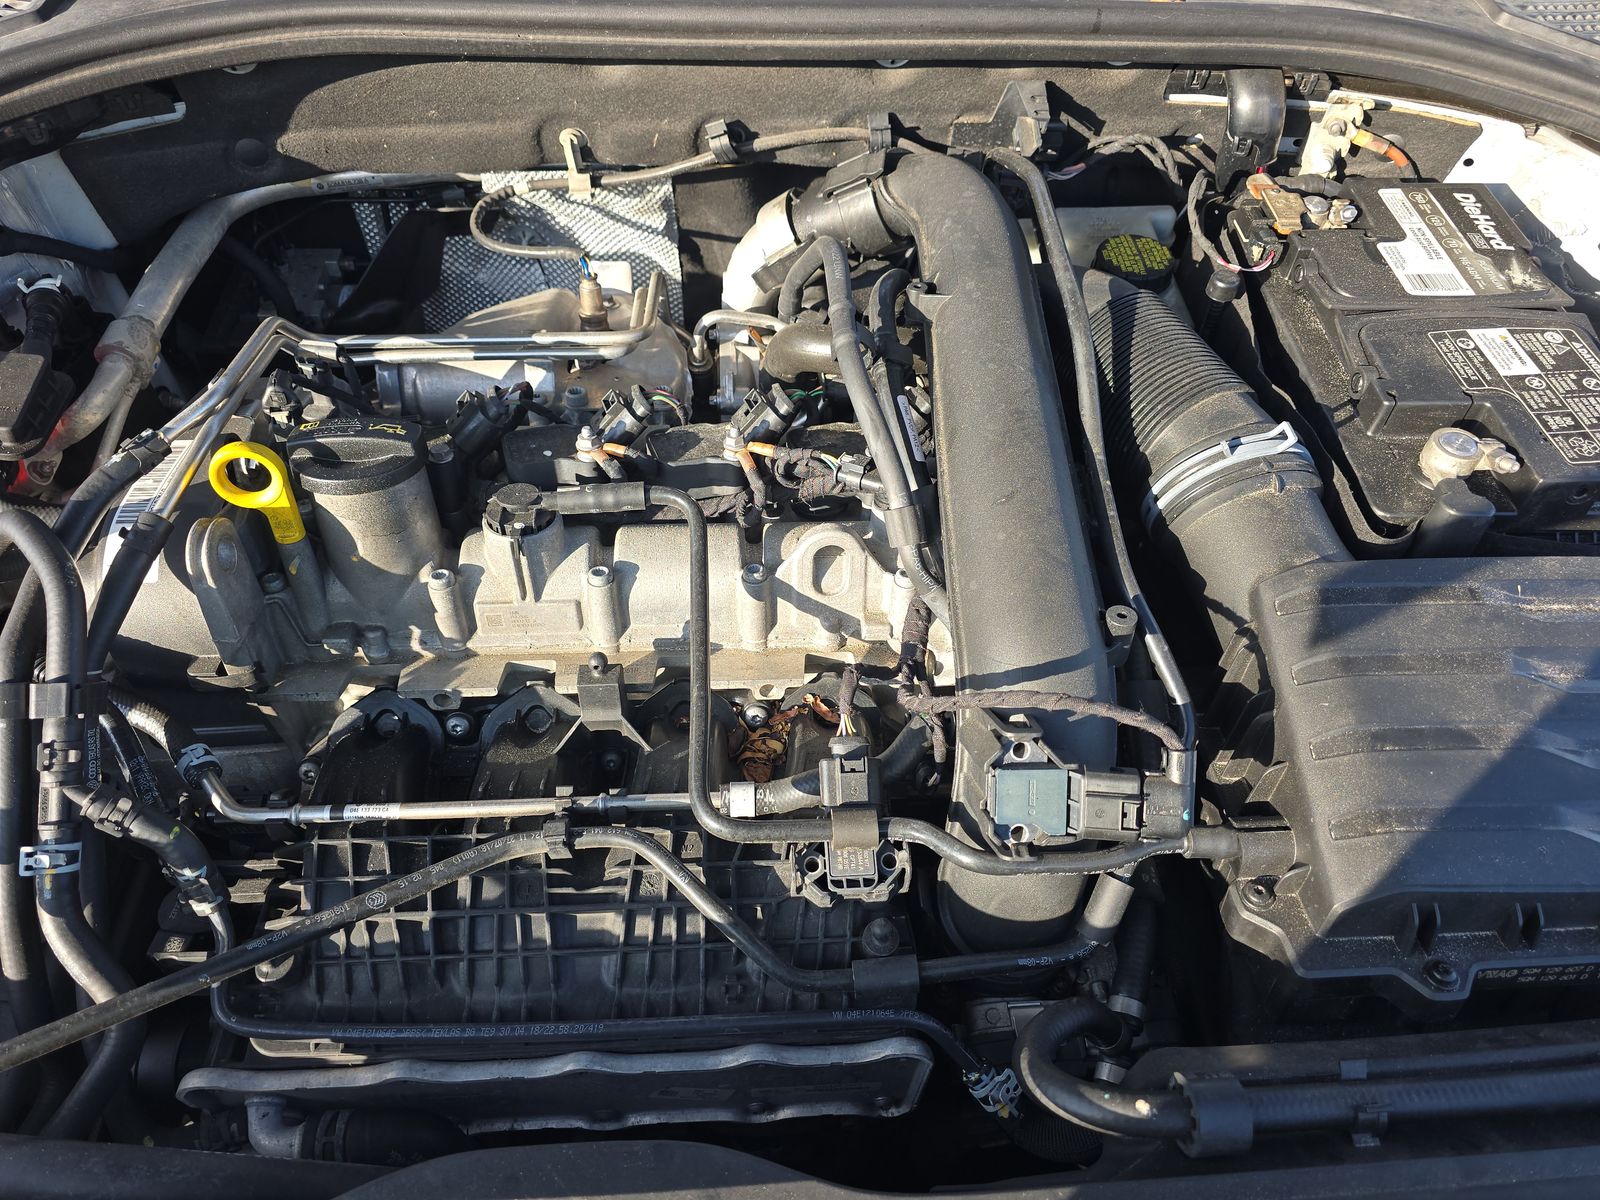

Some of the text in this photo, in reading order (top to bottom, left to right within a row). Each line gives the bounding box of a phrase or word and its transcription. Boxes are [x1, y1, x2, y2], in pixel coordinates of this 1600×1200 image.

[1452, 192, 1515, 250] DieHard
[1552, 416, 1567, 426] NOT
[431, 1027, 460, 1037] TEKLAS
